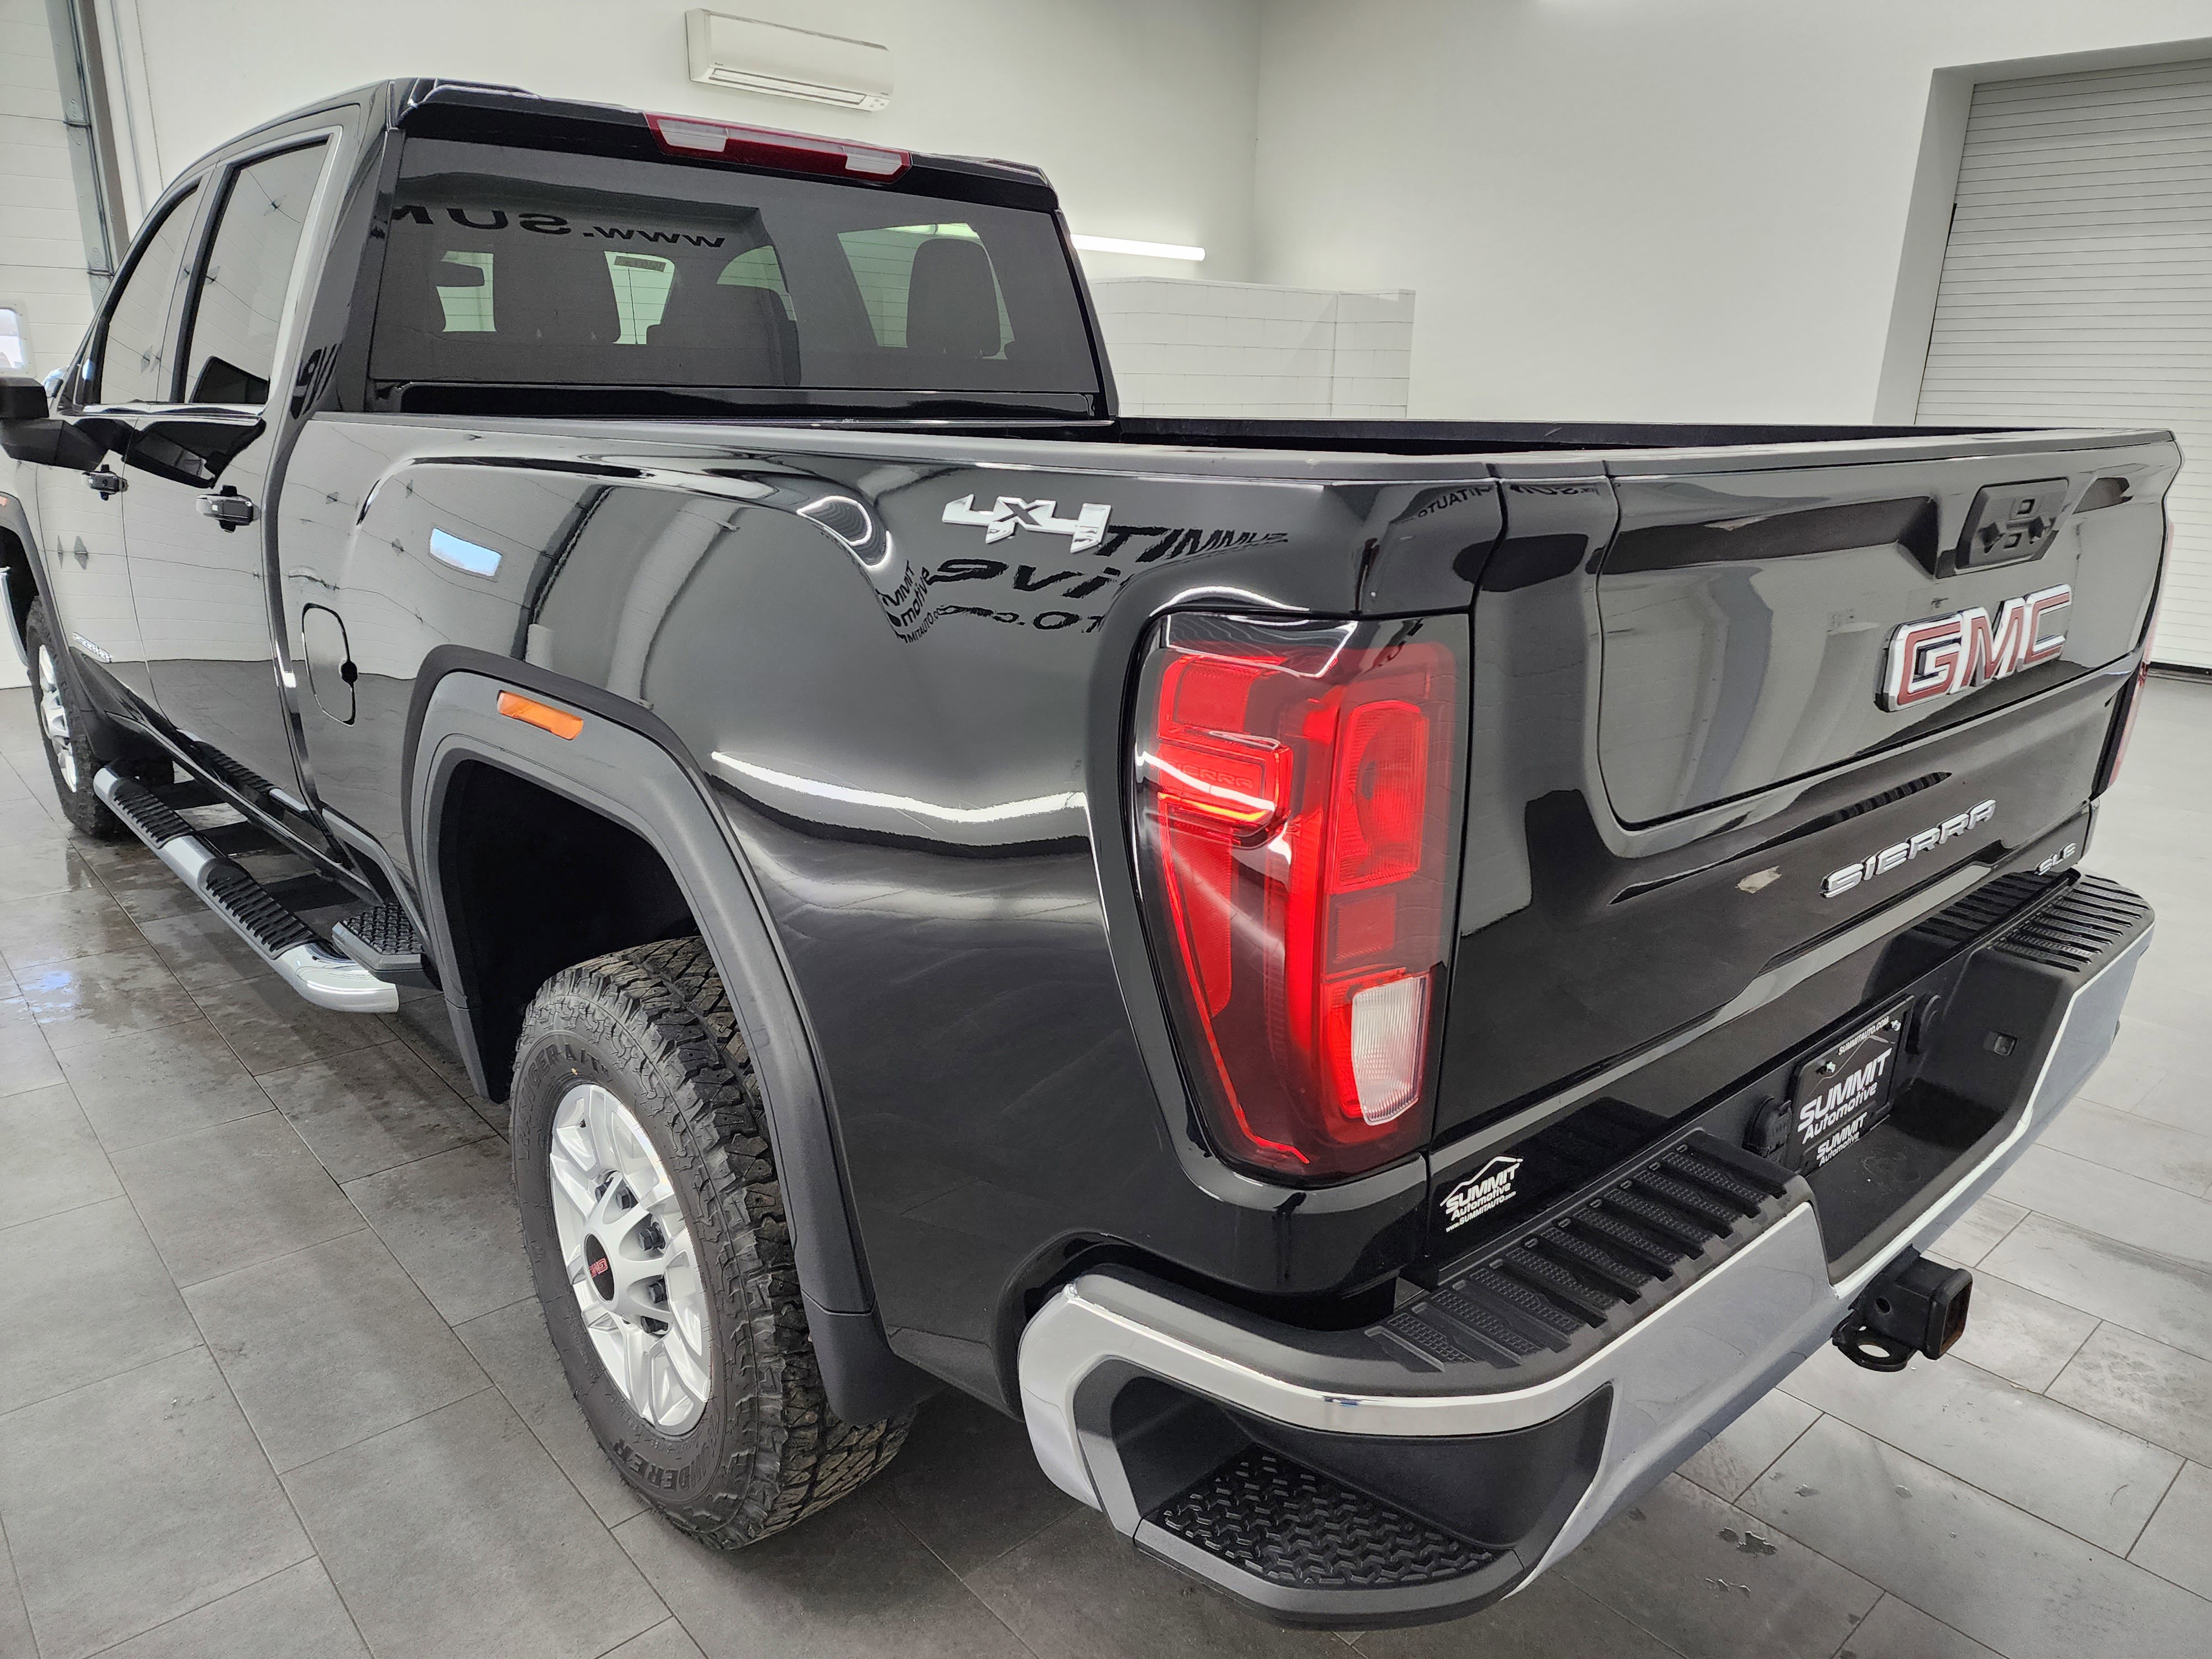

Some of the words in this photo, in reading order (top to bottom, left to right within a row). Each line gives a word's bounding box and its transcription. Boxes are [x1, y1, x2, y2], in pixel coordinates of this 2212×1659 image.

[1874, 583, 2073, 713] GMC
[1819, 799, 1997, 898] SIERRA
[2034, 842, 2076, 876] SLE
[1838, 1016, 1890, 1056] SUMMITAUTO.COM
[1797, 1047, 1892, 1133] SUMMIT
[1802, 1082, 1877, 1145] Automotive
[1816, 1112, 1867, 1161] SUMMIT
[1819, 1131, 1860, 1167] Automotive
[1445, 1163, 1520, 1215] SUMMIT
[1446, 1191, 1517, 1233] www.SUMMITAUTO.com
[1451, 1182, 1511, 1222] Automotive
